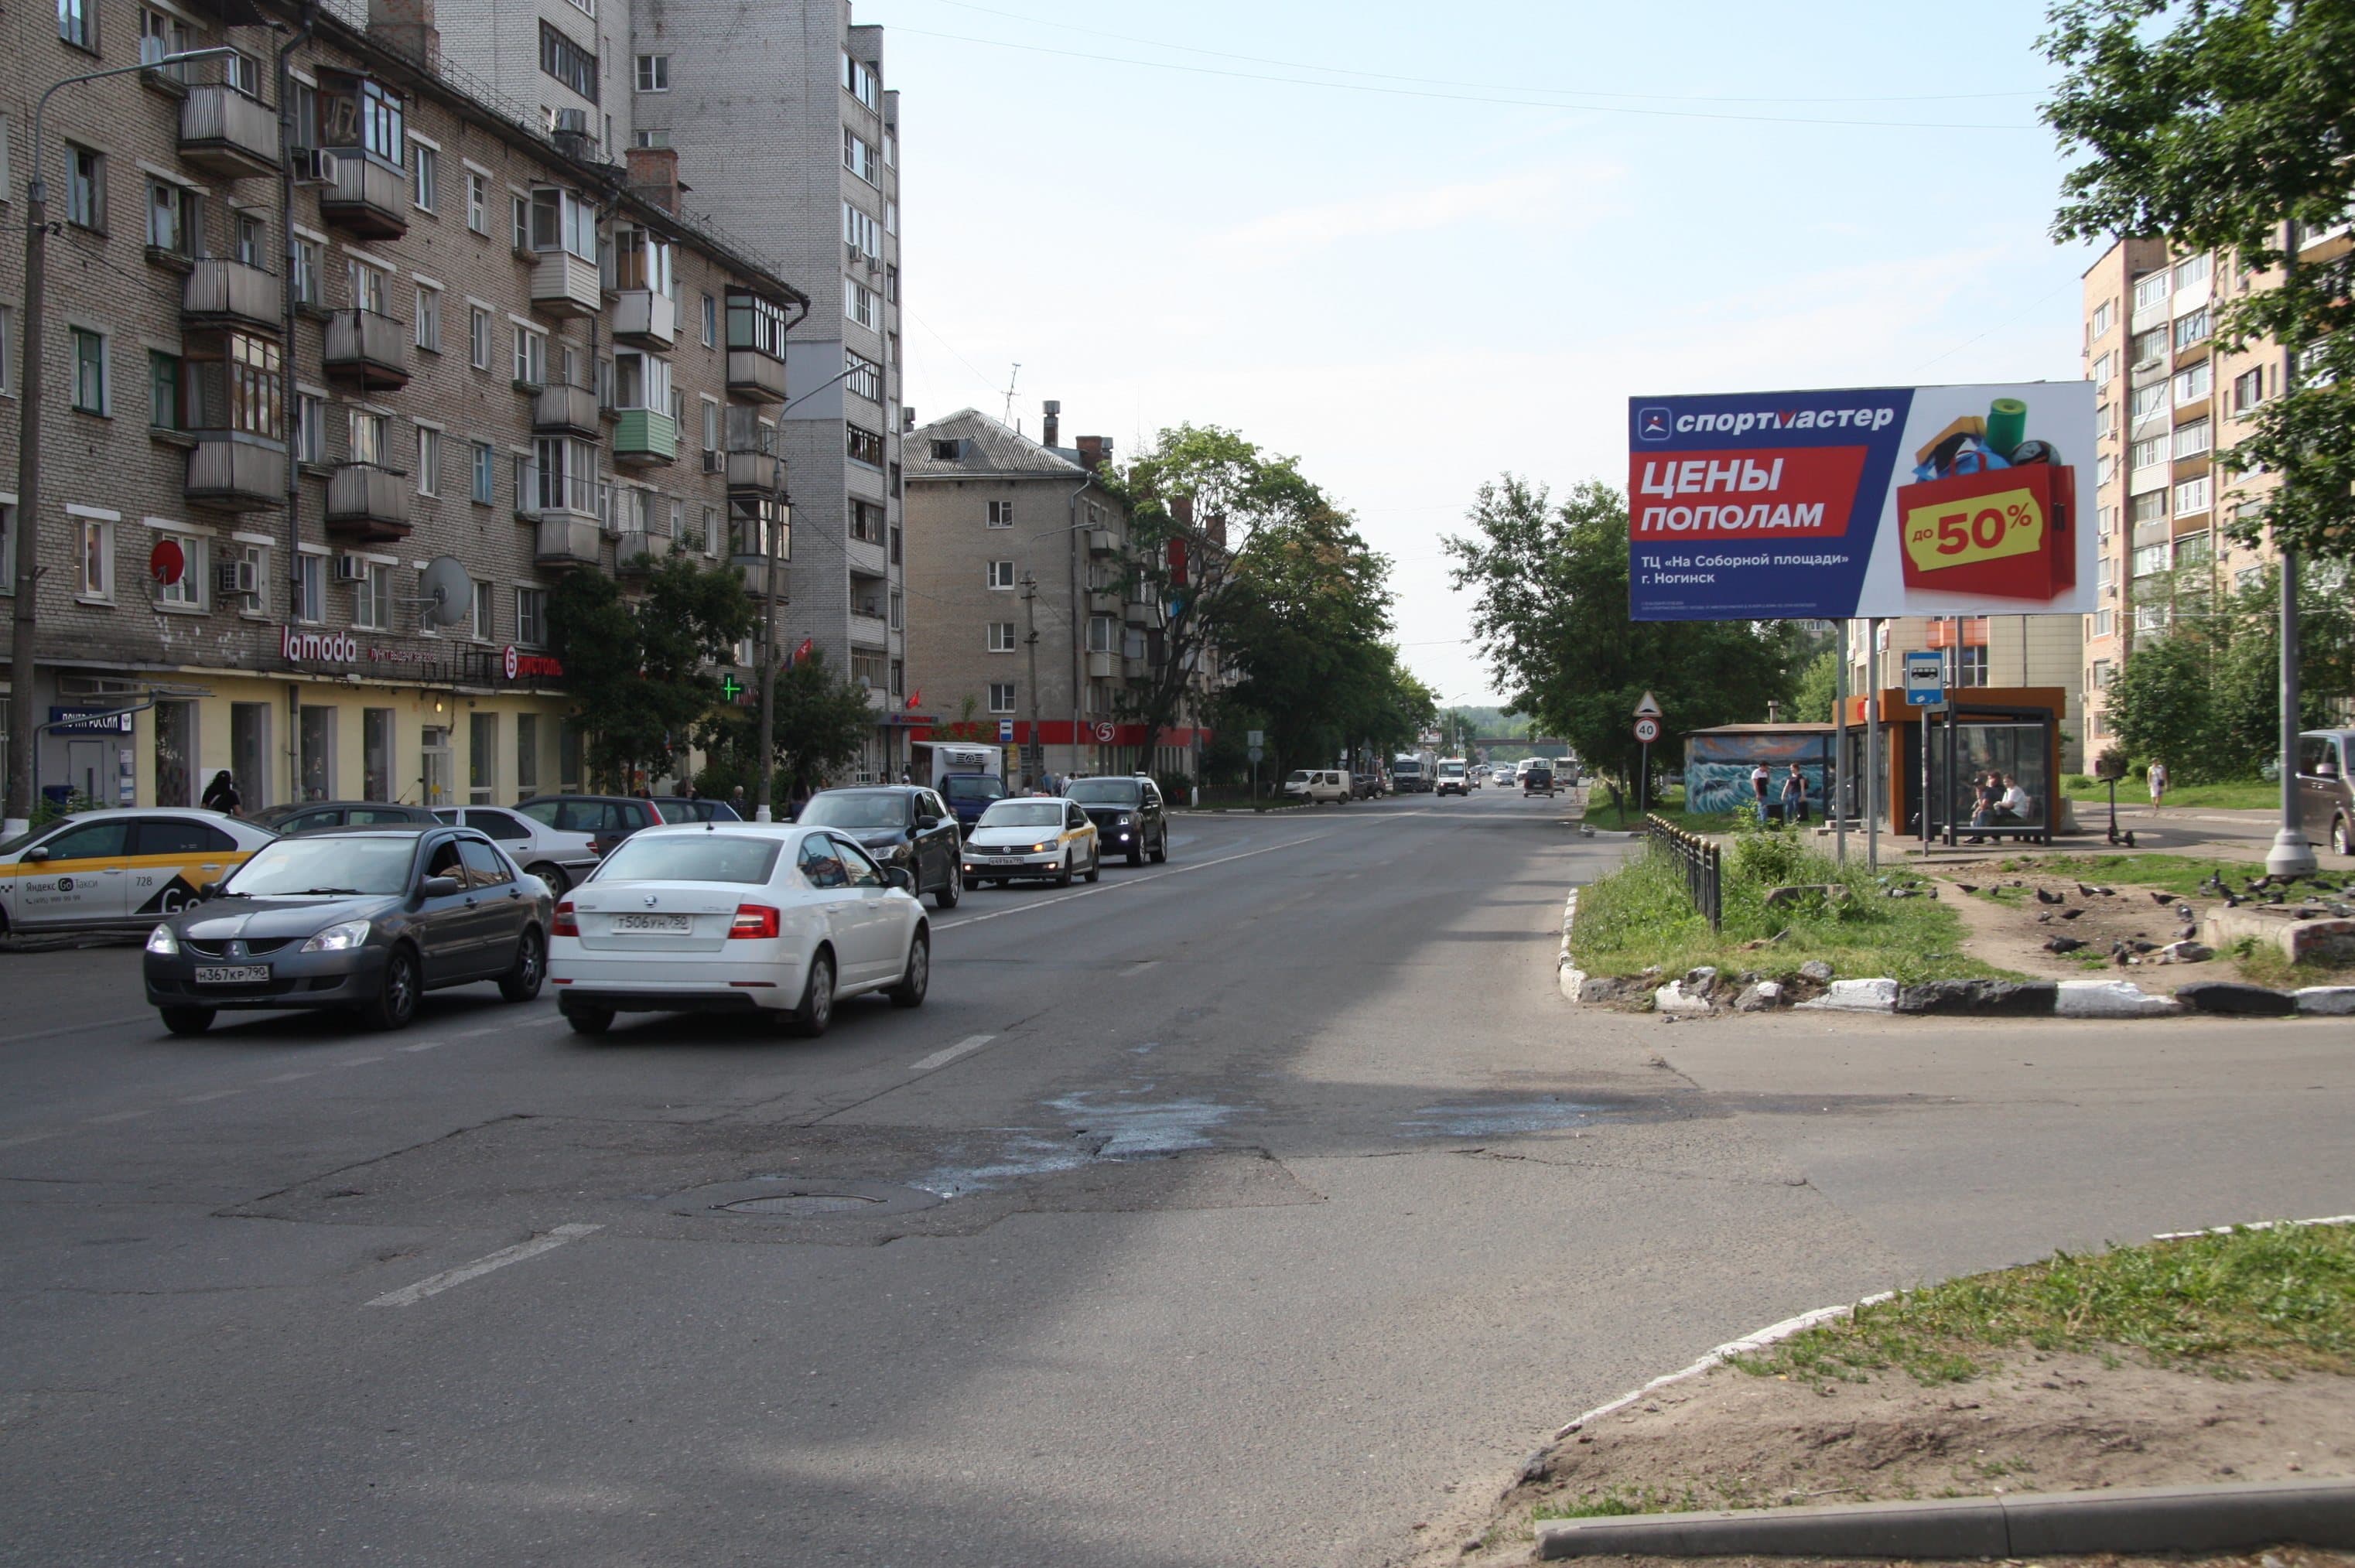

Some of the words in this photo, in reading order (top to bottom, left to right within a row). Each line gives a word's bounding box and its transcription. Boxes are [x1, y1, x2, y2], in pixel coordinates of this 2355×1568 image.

[1676, 407, 1895, 436] спортмастер
[1639, 457, 1784, 500] ЦЕНЫ
[1639, 502, 1825, 531] ПОПОЛАМ
[1936, 502, 2032, 555] 50%
[1641, 556, 1660, 569] ТЦ
[1664, 555, 1690, 567] «На
[1694, 553, 1770, 569] Соборной
[1773, 554, 1849, 566] площади»
[1641, 576, 1650, 584] г.
[1654, 572, 1715, 584] Ногинск
[281, 624, 357, 663] lamoda
[1639, 725, 1653, 735] 40
[26, 881, 56, 892] Яндекс
[60, 880, 72, 890] Go
[75, 878, 98, 890] Такси
[136, 876, 152, 886] 728
